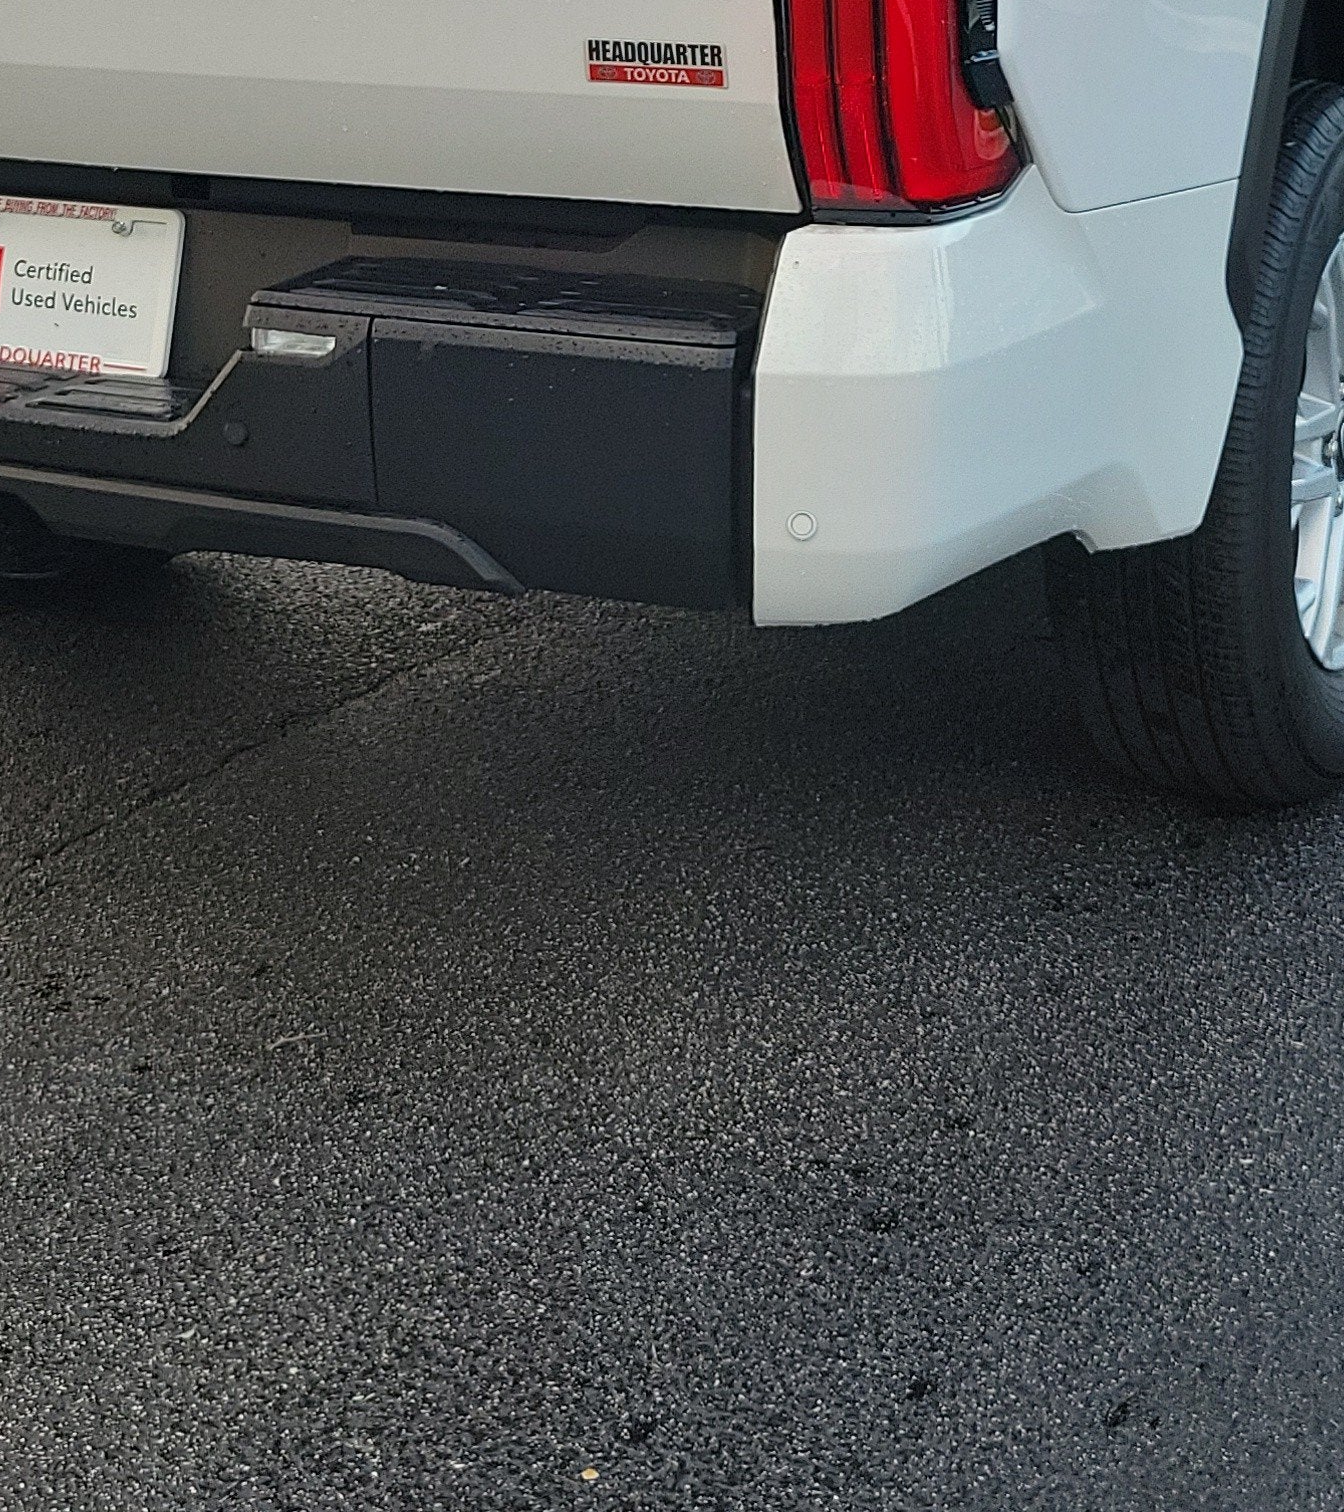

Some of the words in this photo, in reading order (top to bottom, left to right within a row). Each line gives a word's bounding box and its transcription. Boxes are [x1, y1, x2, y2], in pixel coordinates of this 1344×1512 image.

[587, 39, 723, 67] HEADQUARTER
[624, 67, 690, 84] TOYOTA
[36, 201, 59, 217] FROM
[62, 203, 77, 218] THE
[14, 258, 94, 285] Certified
[11, 287, 57, 310] Used
[62, 292, 138, 319] Vehicles
